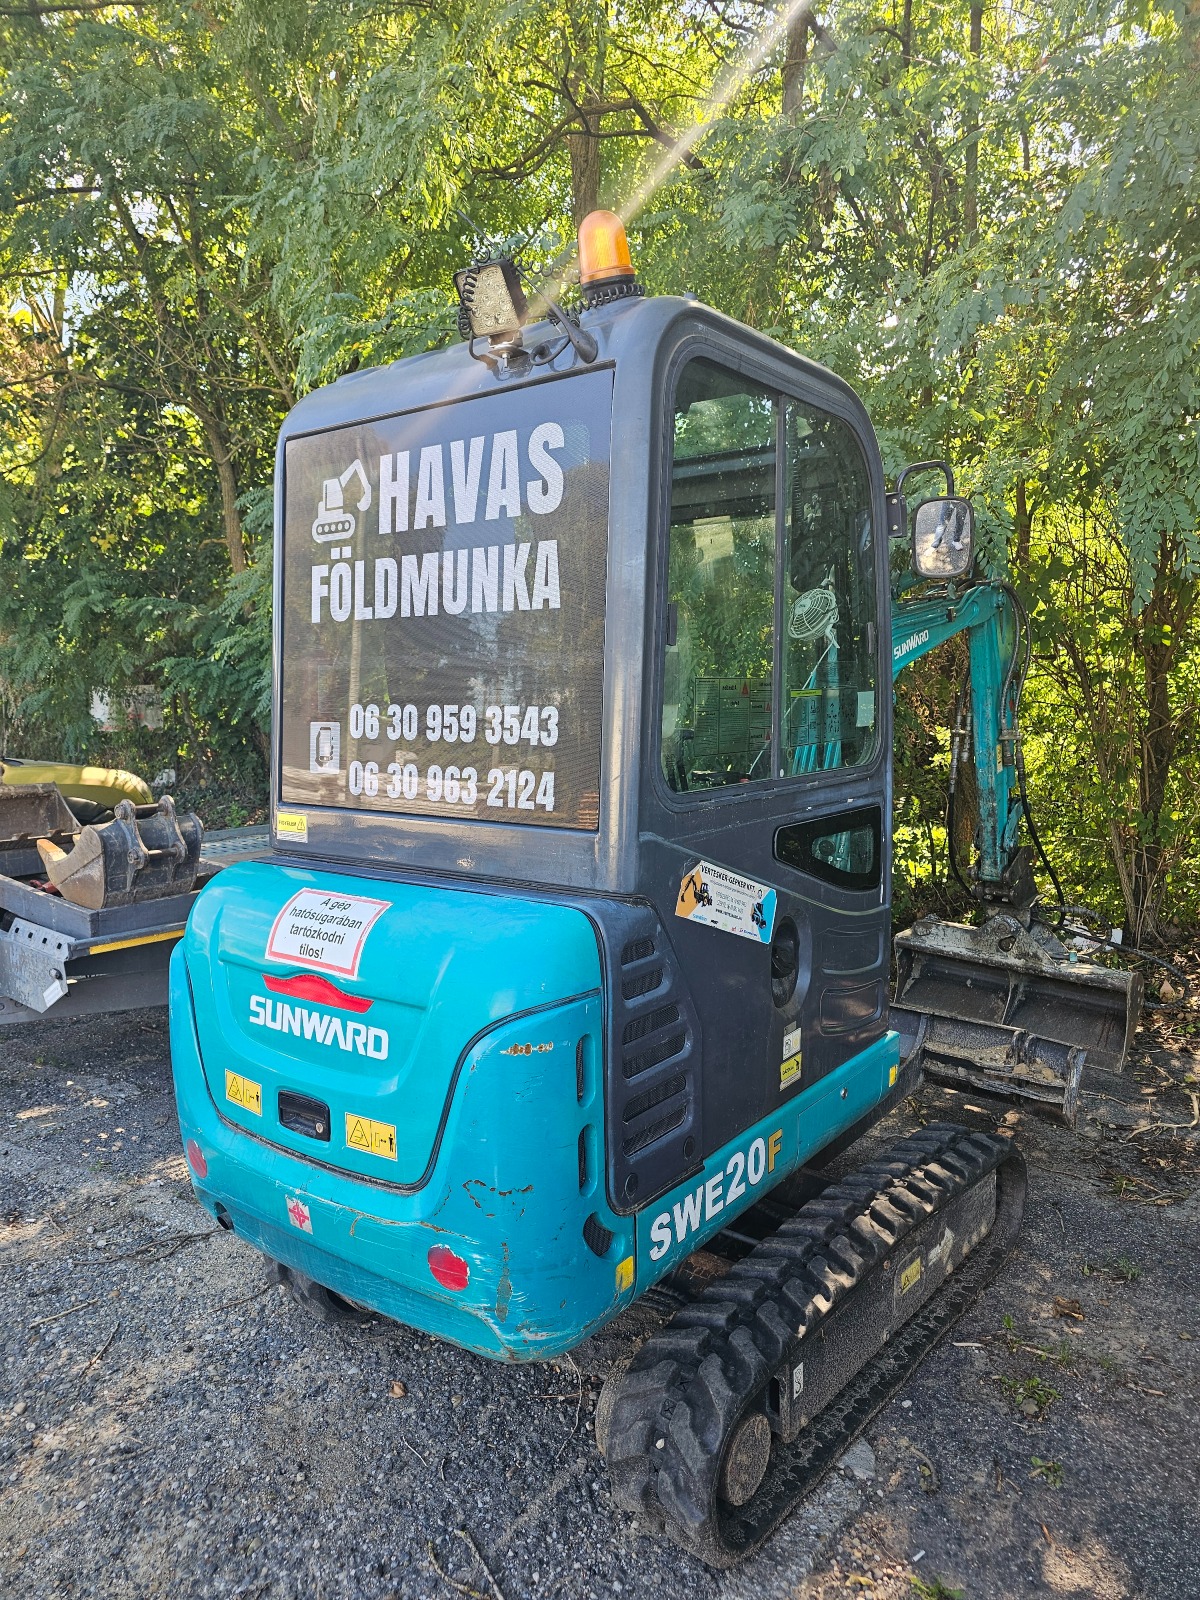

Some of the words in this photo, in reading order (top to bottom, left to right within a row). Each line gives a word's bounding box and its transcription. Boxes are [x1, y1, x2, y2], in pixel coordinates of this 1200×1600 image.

[377, 422, 565, 535] HAVAS
[311, 540, 562, 623] FÖLDMUNKA
[893, 629, 929, 660] SUNWARD
[350, 704, 379, 740] 06
[386, 704, 418, 740] 30
[426, 704, 477, 743] 959
[485, 705, 559, 747] 3543
[349, 761, 379, 796] 06
[386, 763, 418, 800] 30
[426, 765, 478, 805] 963
[487, 769, 555, 811] 2124
[289, 906, 362, 930] hatósugarában
[320, 898, 332, 907] A
[332, 899, 351, 911] gép
[289, 923, 346, 945] tartózkodni
[299, 944, 324, 960] tilos!
[250, 994, 388, 1061] SUNWARD
[650, 1129, 783, 1261] SWE20F
